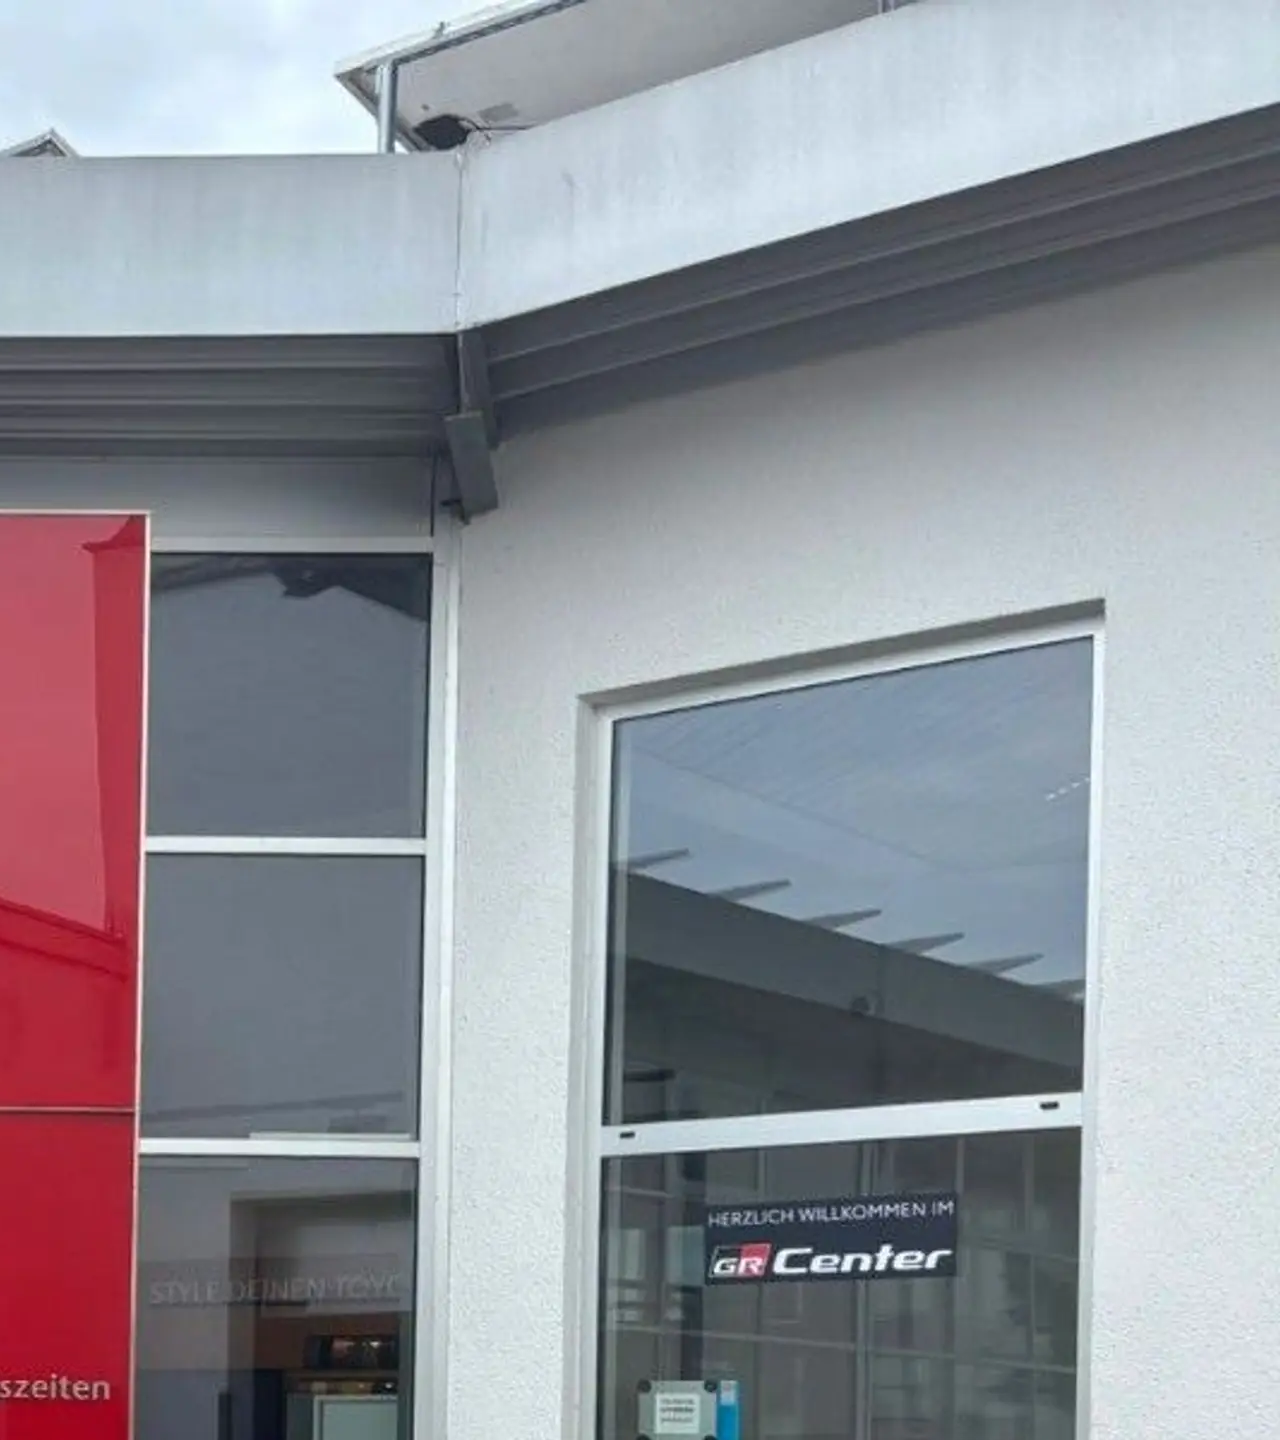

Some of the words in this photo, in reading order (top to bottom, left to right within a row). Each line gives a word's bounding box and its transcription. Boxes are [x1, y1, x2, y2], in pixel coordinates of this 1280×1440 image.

[708, 1208, 793, 1227] HERZLICH
[800, 1203, 927, 1221] WILLKOMMEN
[931, 1201, 954, 1216] IM
[713, 1256, 765, 1276] GR
[773, 1244, 953, 1275] Center
